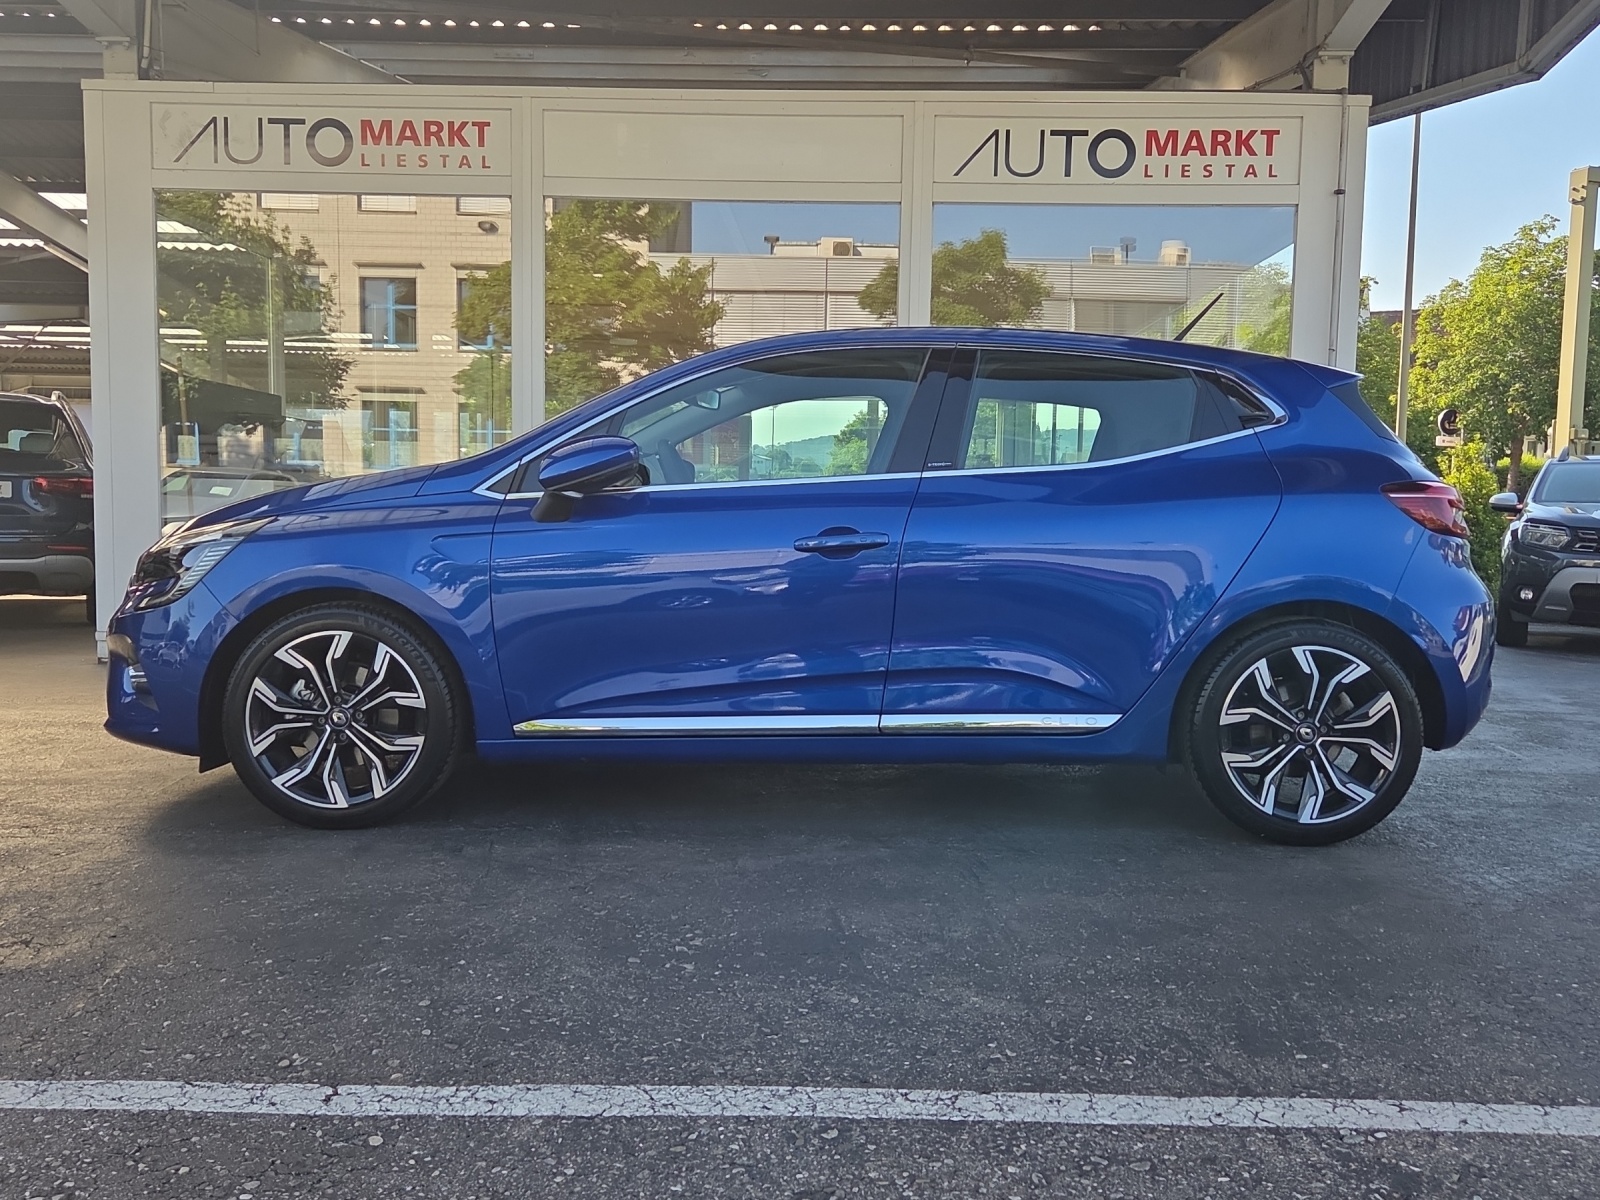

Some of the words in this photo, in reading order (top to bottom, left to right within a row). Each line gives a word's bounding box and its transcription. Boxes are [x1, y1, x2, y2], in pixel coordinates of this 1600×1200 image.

[172, 116, 354, 167] AUTO
[360, 119, 491, 148] MARKT
[953, 128, 1136, 179] AUTO
[1145, 129, 1281, 157] MARKT
[360, 153, 491, 169] LIESTAL
[1144, 164, 1278, 178] LIESTAL
[382, 627, 434, 679] MICHELIN
[1318, 630, 1385, 662] MICHELIN
[1041, 716, 1098, 726] CLIO
